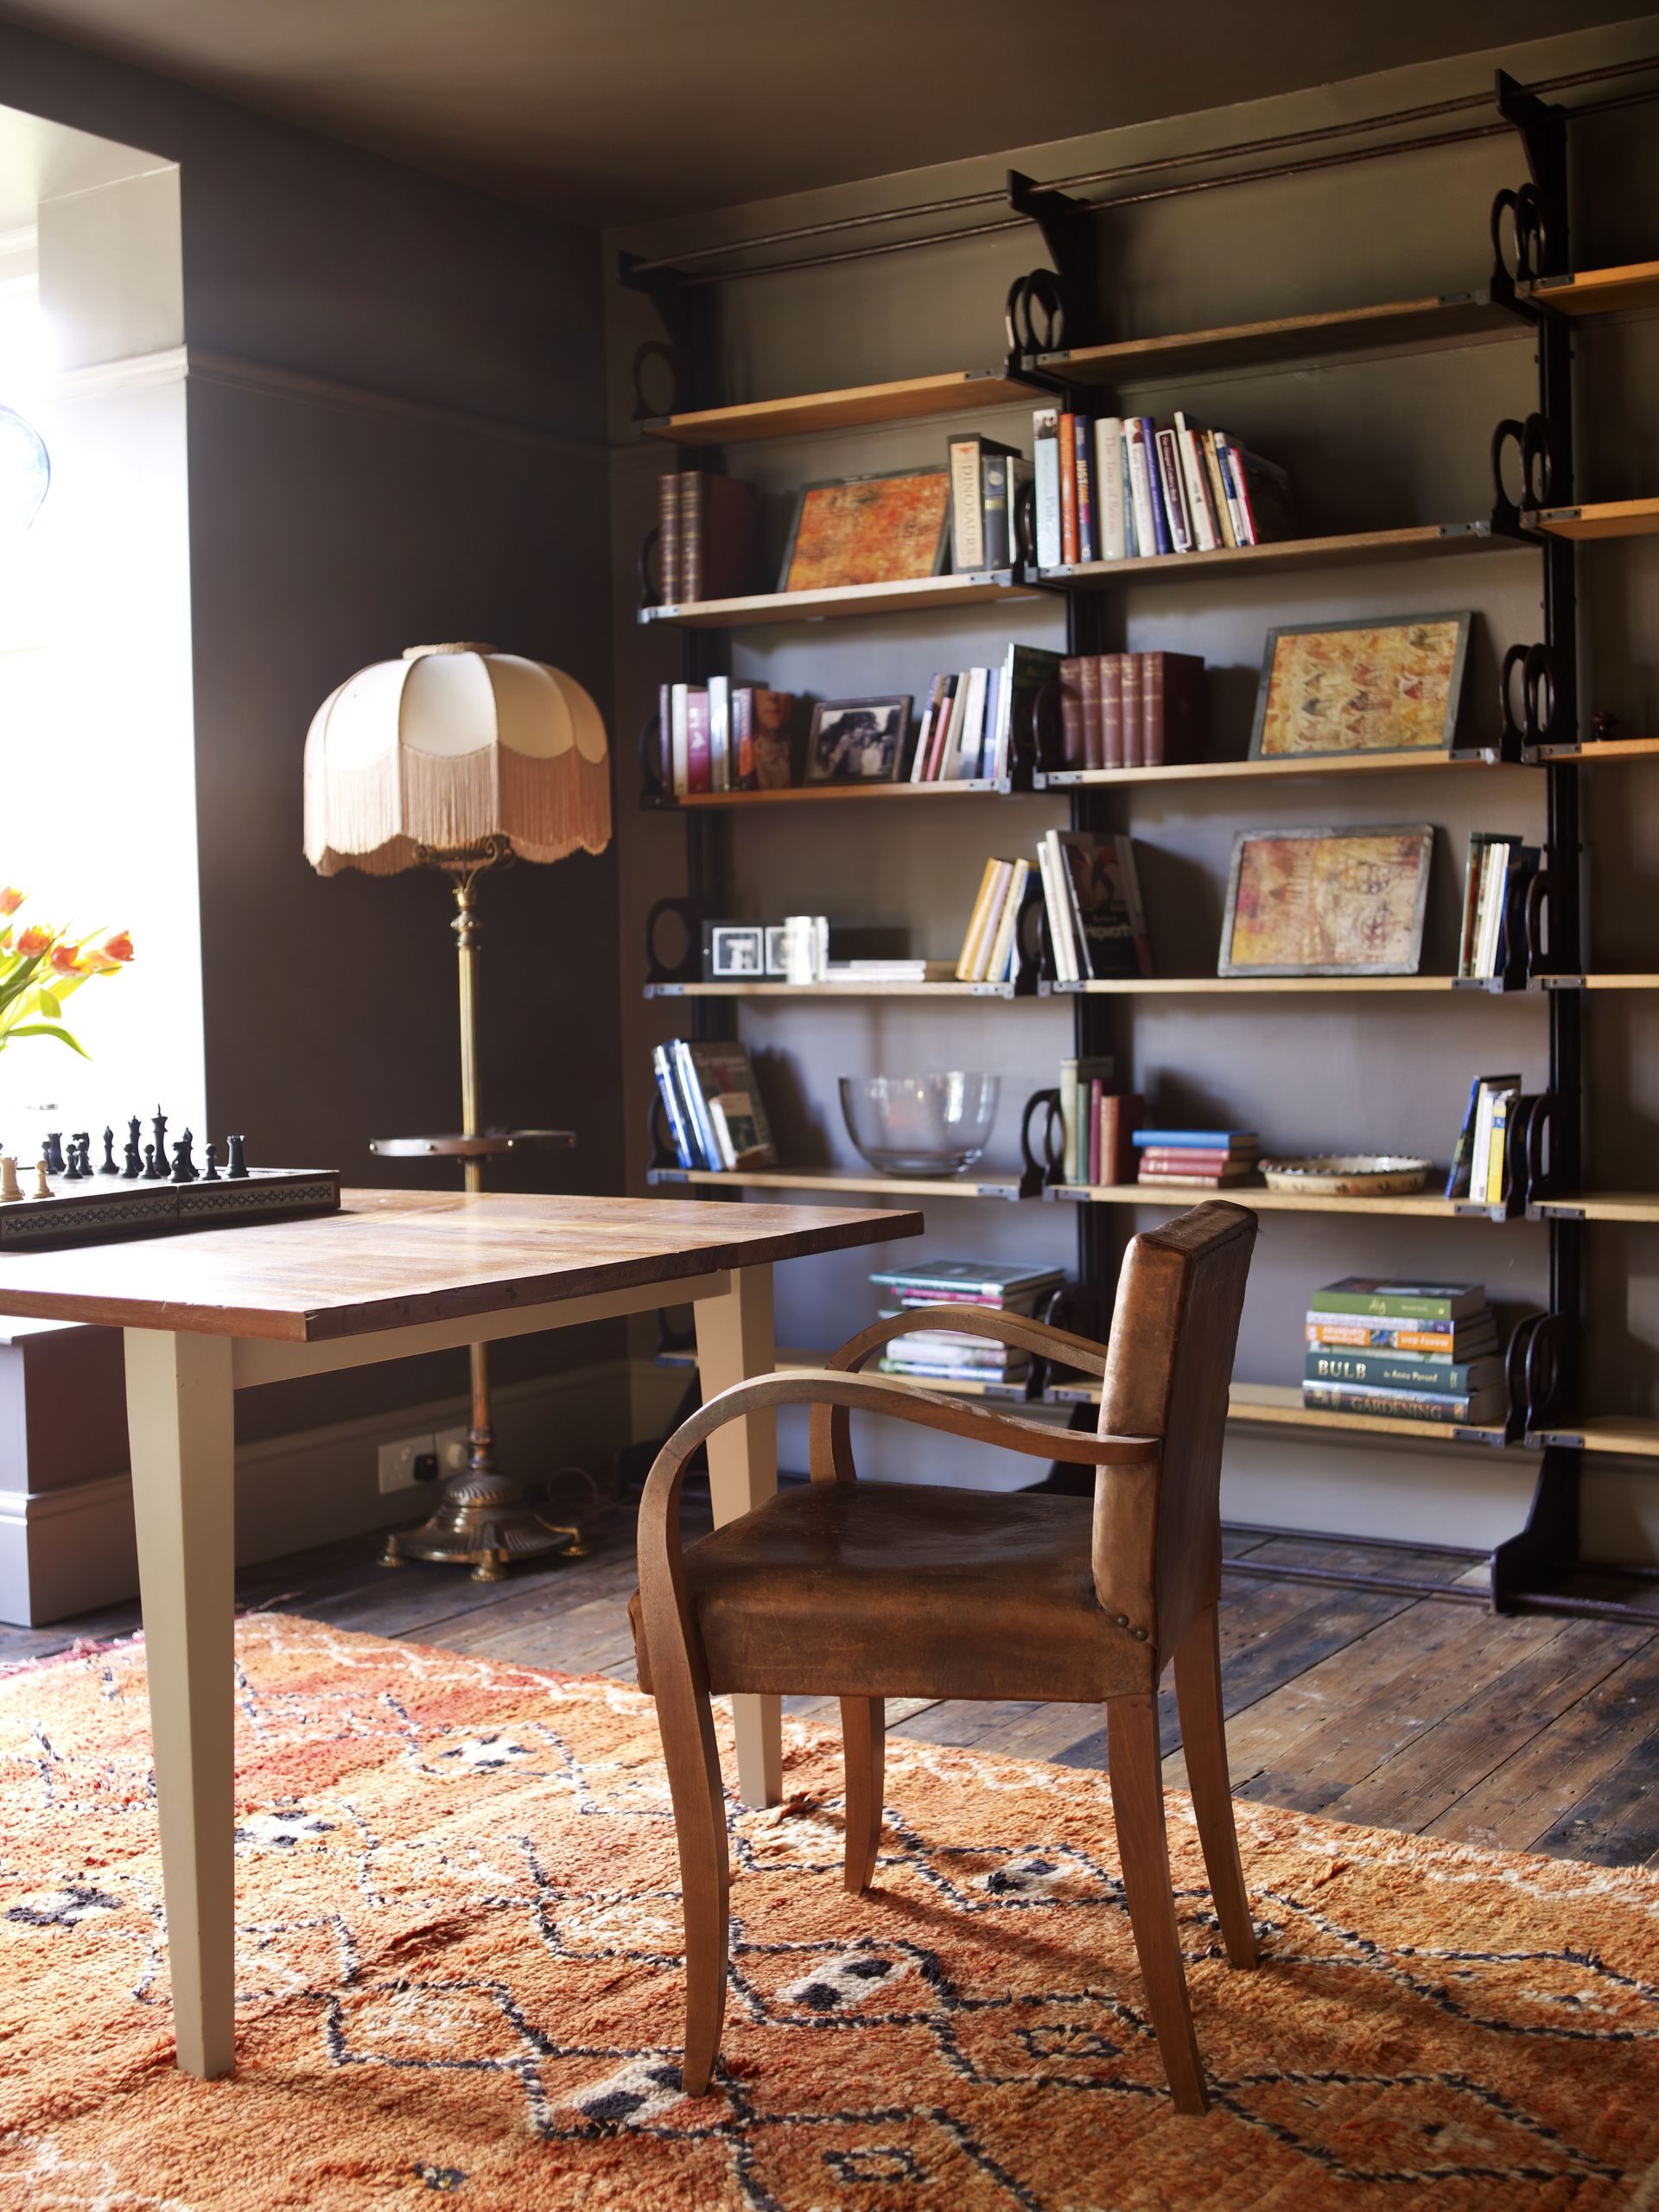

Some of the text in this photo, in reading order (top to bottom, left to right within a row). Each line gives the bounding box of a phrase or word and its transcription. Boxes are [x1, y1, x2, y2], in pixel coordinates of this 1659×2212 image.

[962, 465, 976, 555] DINOSAURS
[1318, 1360, 1367, 1380] BULB
[1351, 1396, 1442, 1420] GARDENING
